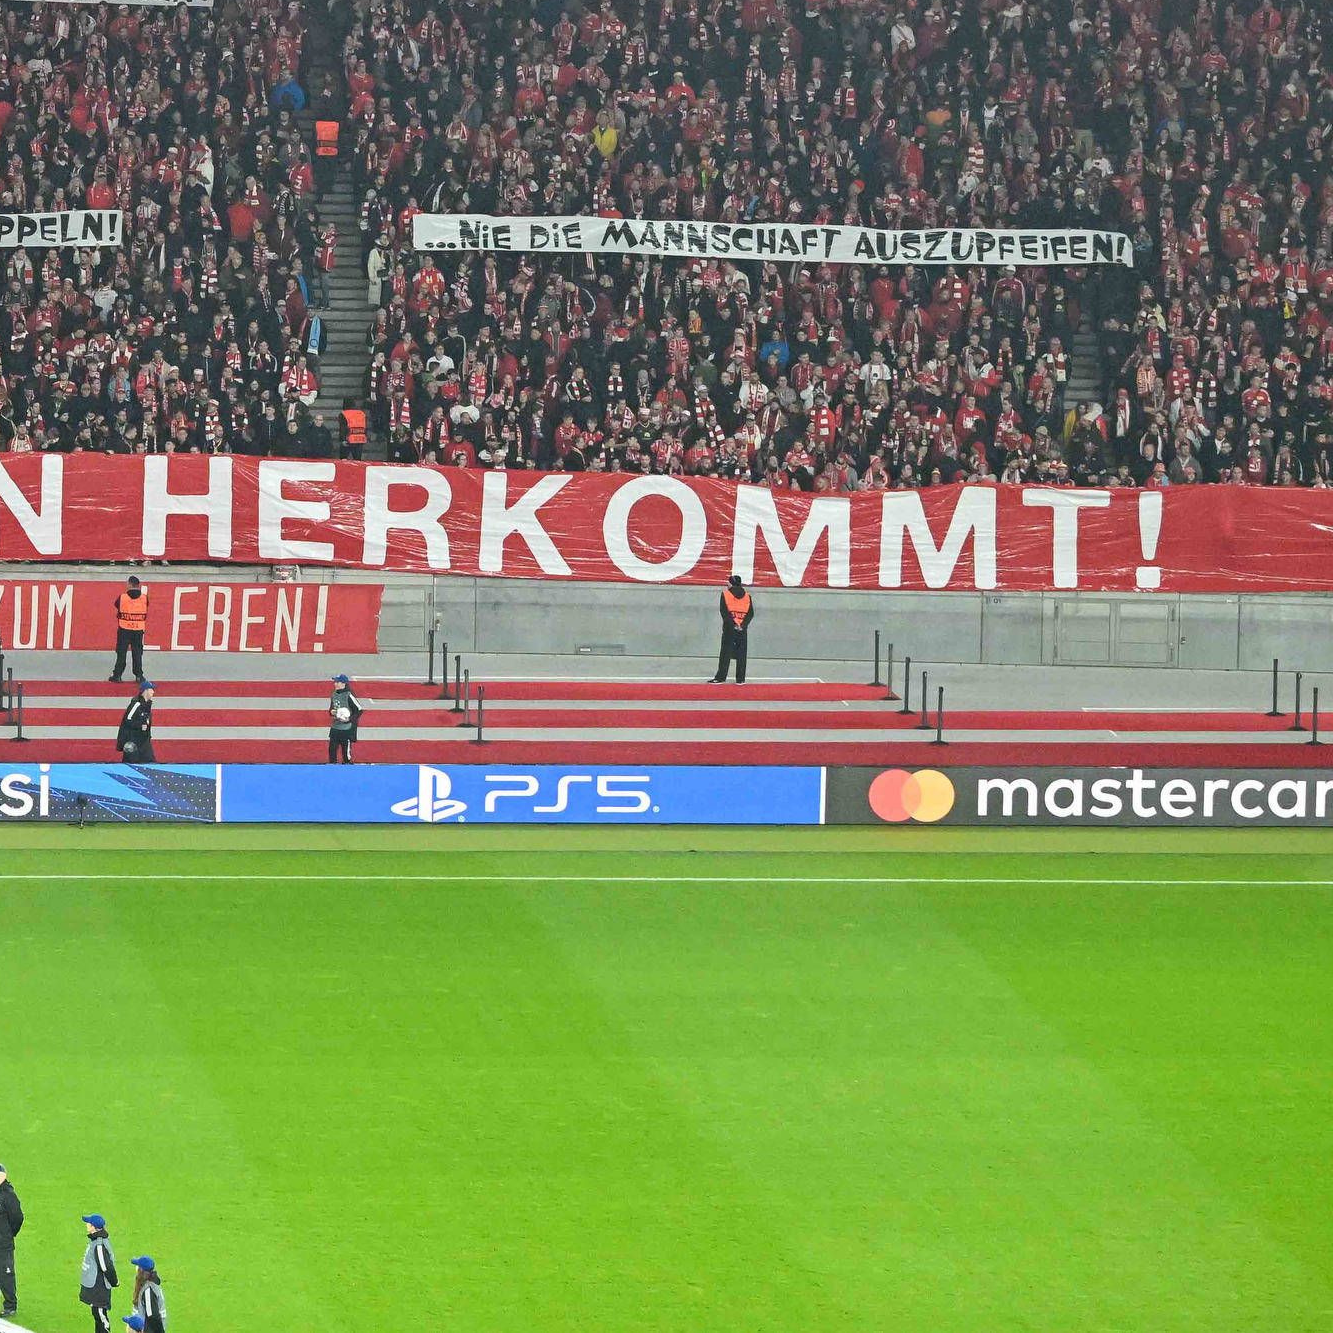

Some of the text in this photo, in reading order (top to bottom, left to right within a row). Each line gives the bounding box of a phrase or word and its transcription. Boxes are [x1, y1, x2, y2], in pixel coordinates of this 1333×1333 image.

[601, 221, 841, 258] MANNSCHAFT
[141, 454, 1162, 590] HERKOMMT!
[484, 775, 652, 813] PS5
